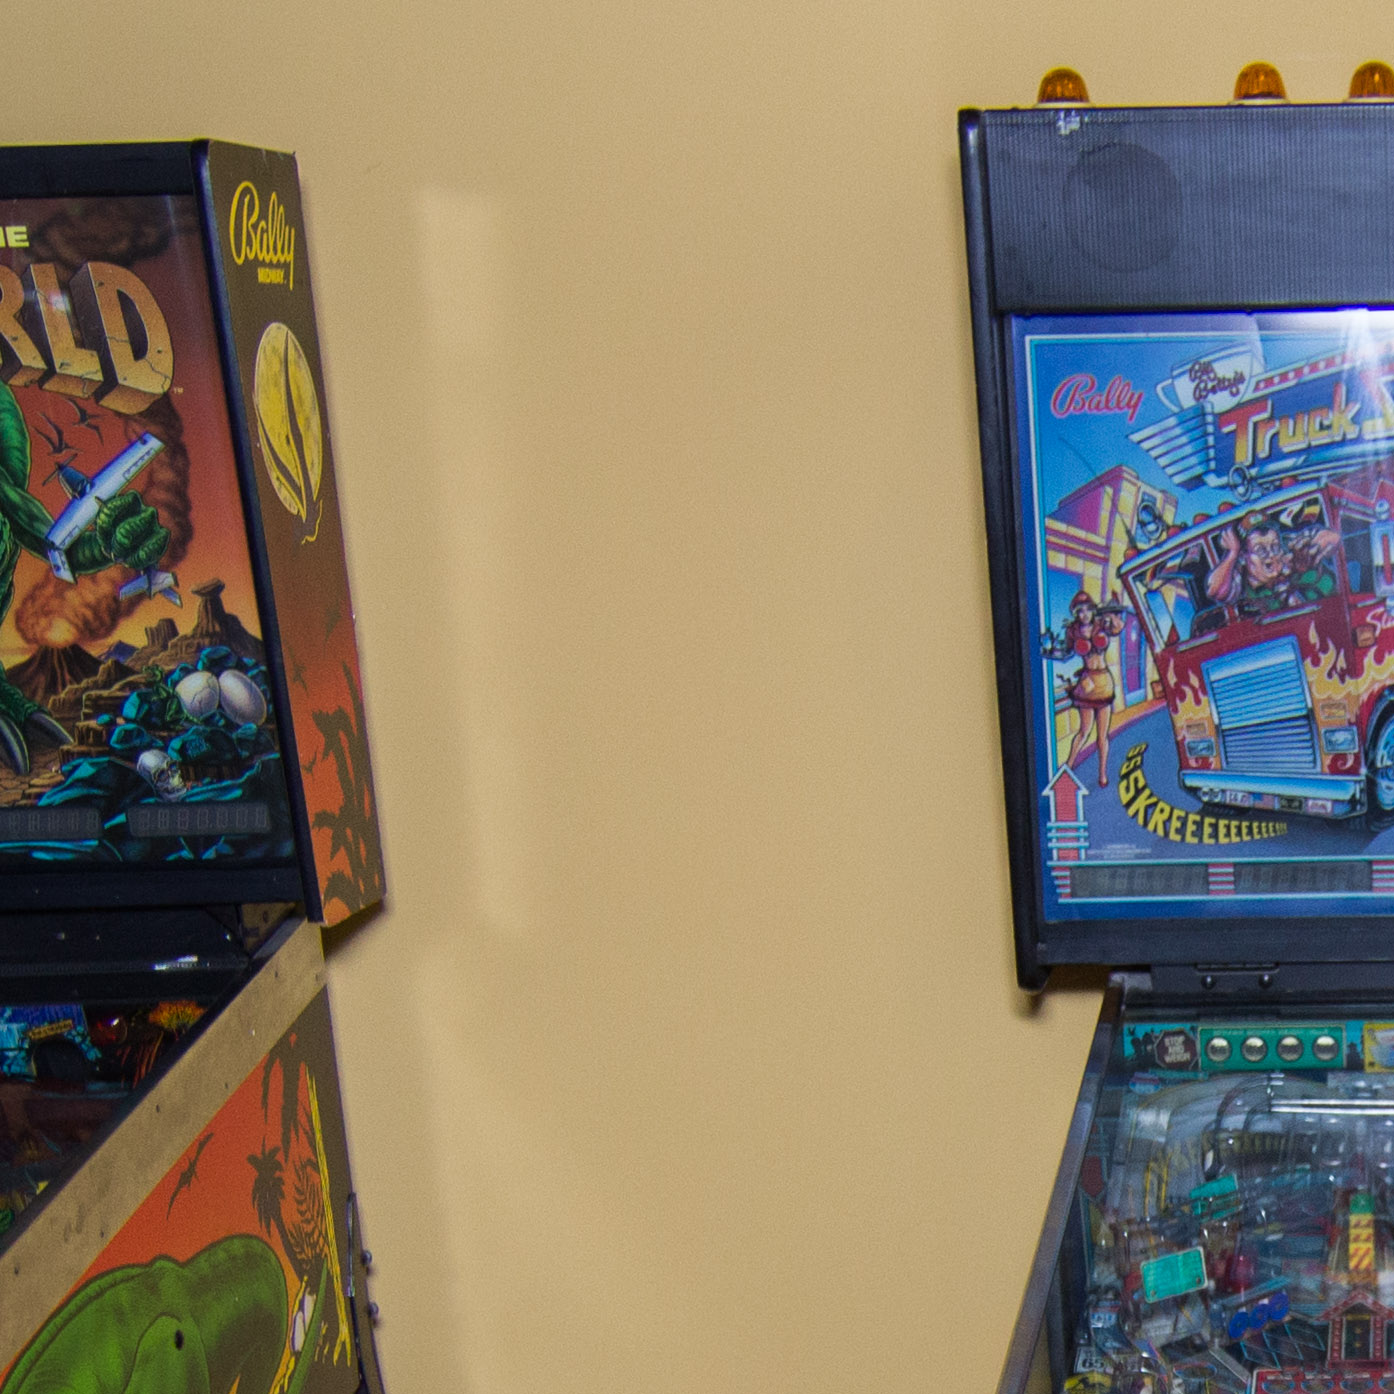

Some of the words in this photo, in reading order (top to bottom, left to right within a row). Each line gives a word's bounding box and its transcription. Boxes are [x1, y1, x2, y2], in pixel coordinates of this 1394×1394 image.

[230, 181, 294, 290] Bally
[1052, 374, 1144, 423] Bally
[1218, 381, 1361, 466] Truck
